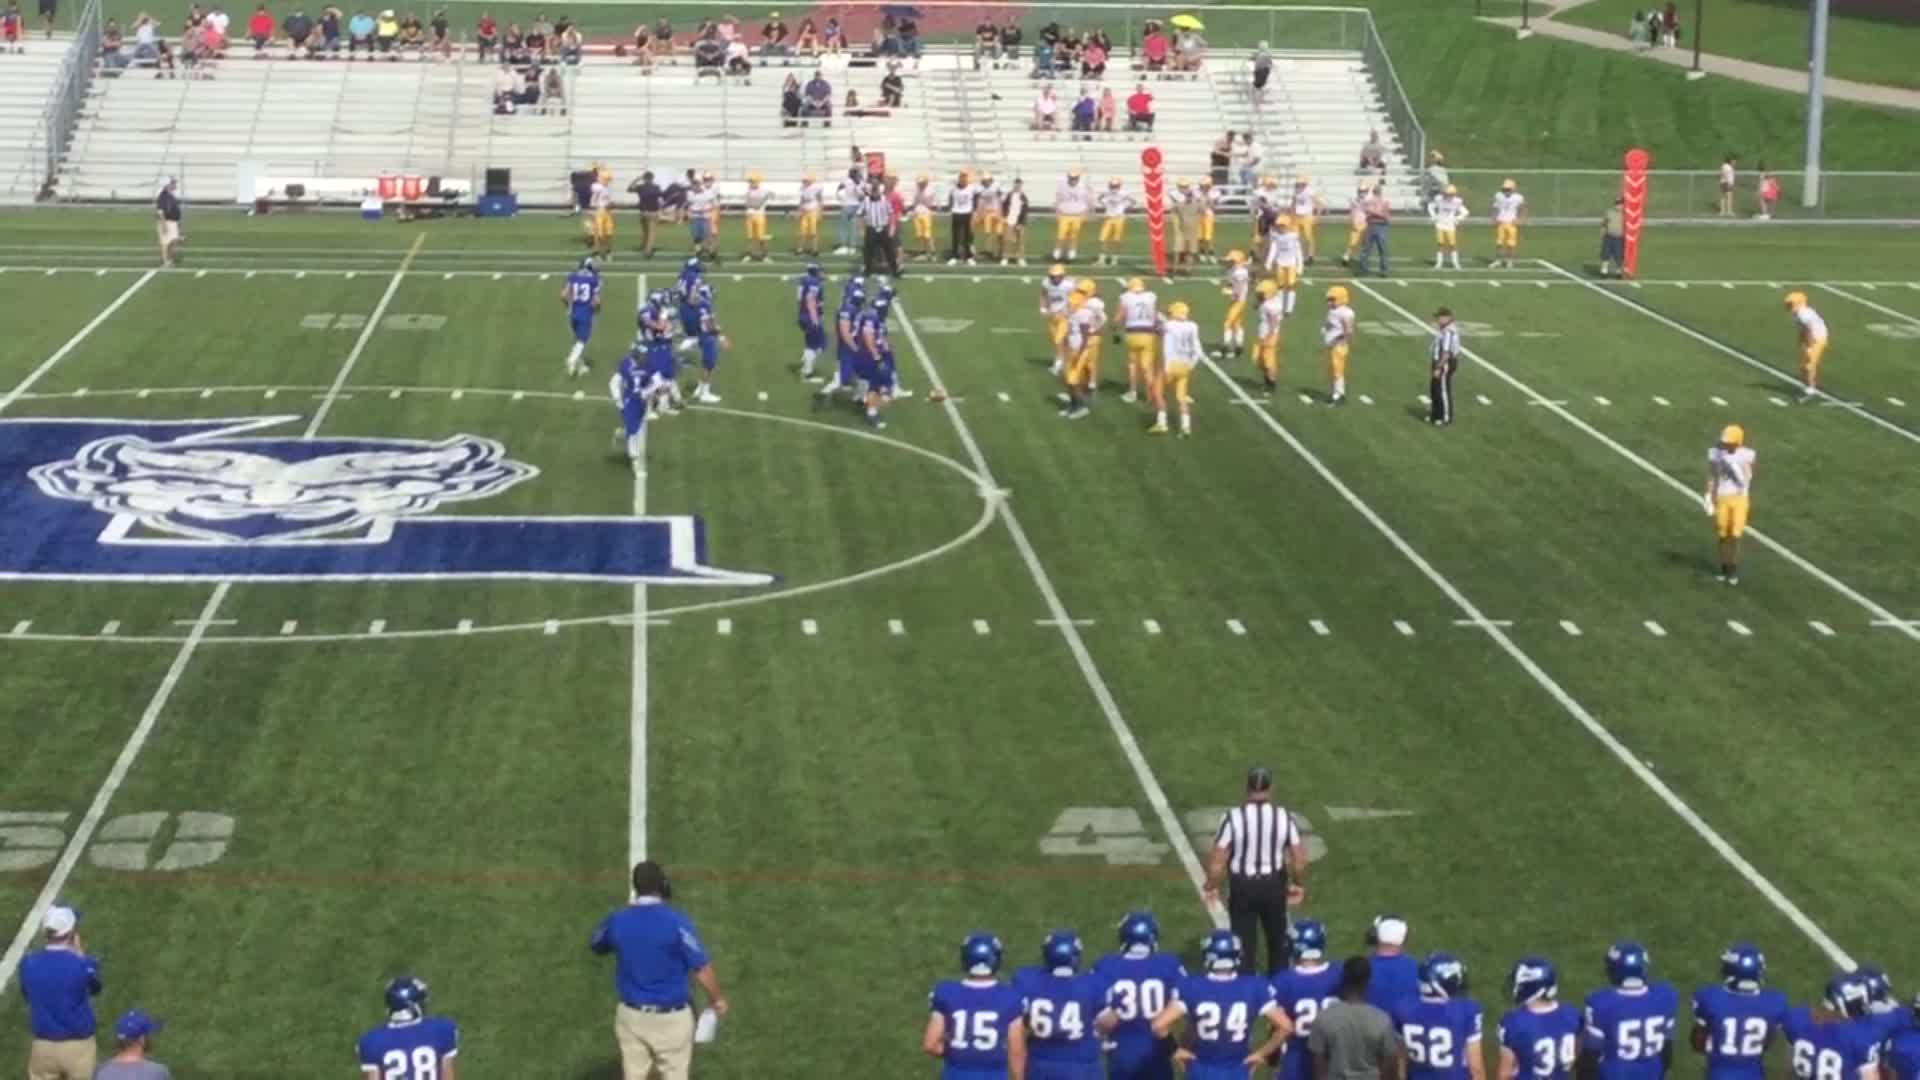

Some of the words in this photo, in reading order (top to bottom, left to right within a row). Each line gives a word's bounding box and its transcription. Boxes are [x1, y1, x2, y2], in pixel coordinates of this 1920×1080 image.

[573, 282, 591, 302] 13
[1029, 998, 1084, 1040] 64
[1113, 978, 1165, 1020] 30
[950, 1009, 999, 1050] 15
[1196, 1001, 1248, 1042] 24
[1617, 1015, 1664, 1060] 55
[1720, 1016, 1768, 1056] 12
[383, 1046, 438, 1080] 28
[1403, 1023, 1454, 1068] 52
[1793, 1039, 1842, 1080] 68
